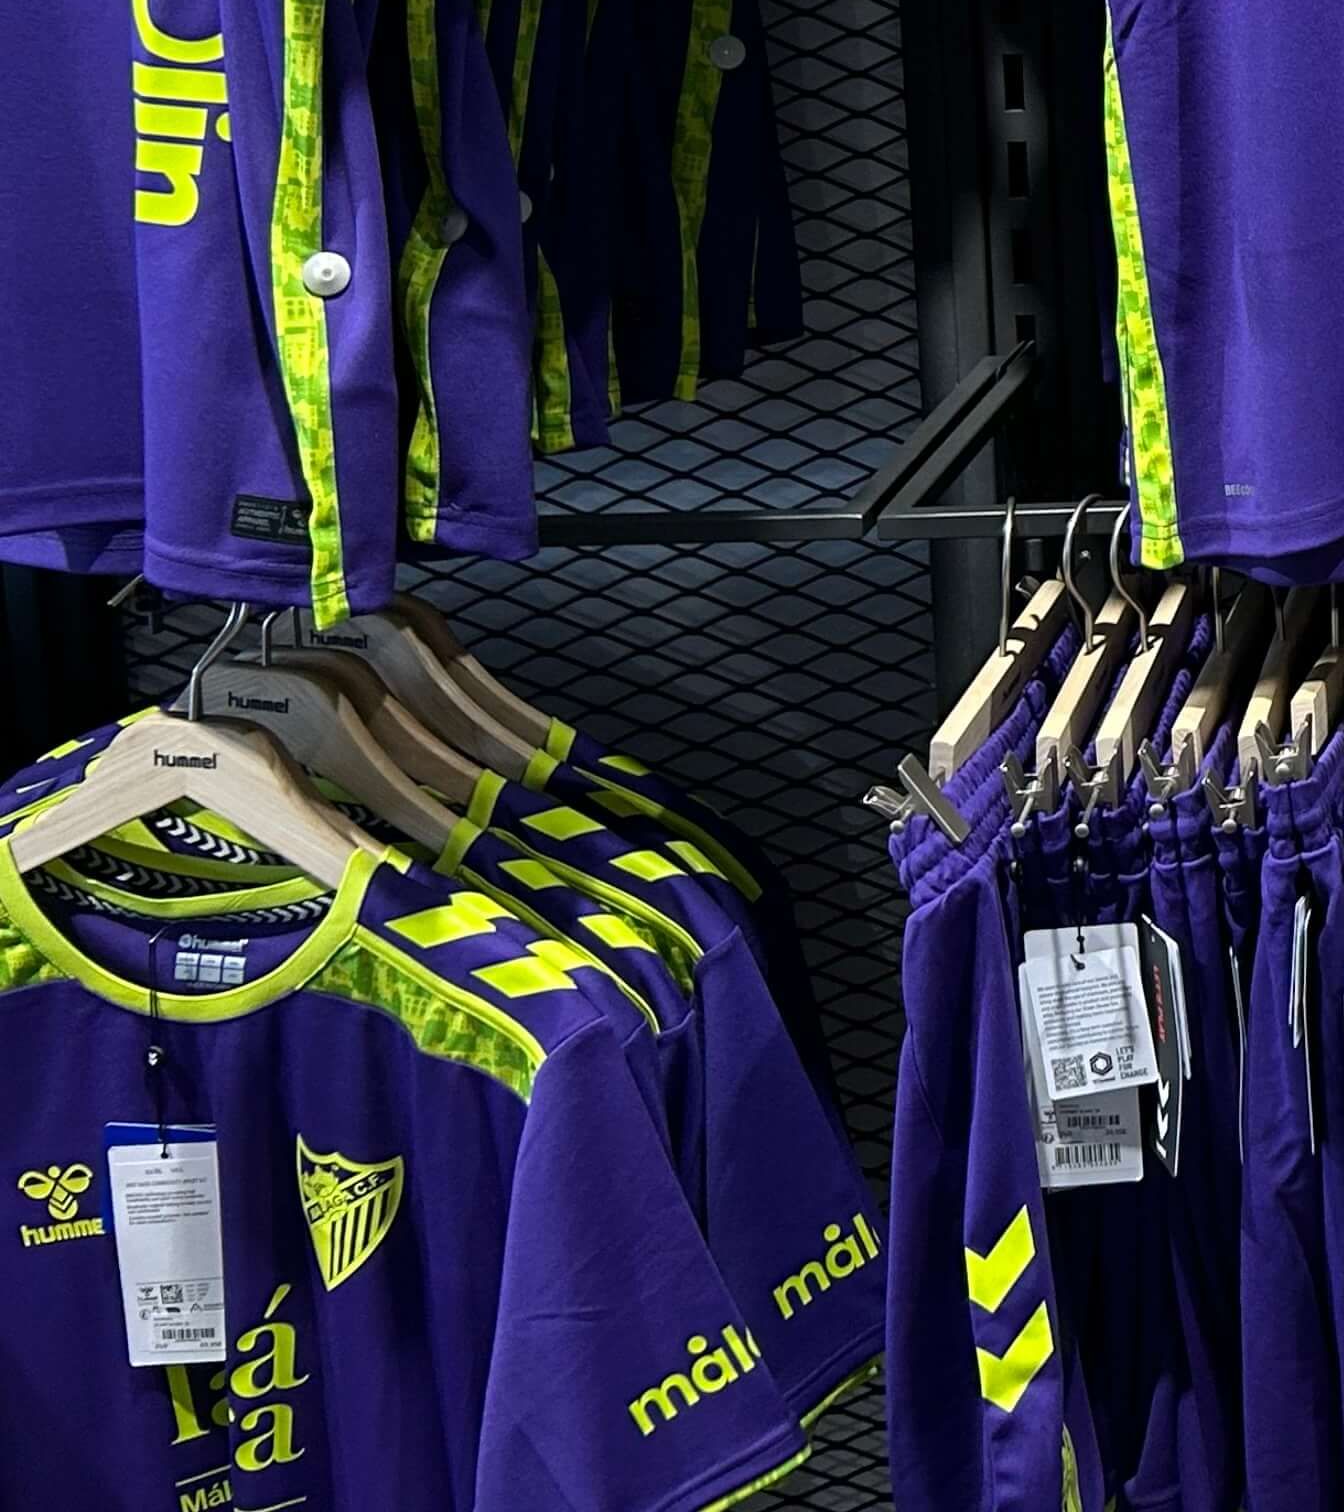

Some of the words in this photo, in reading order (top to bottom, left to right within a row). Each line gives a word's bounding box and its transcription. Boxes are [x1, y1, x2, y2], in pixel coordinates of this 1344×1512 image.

[228, 692, 290, 714] hummel
[153, 750, 217, 769] hummel
[20, 1217, 105, 1247] humme
